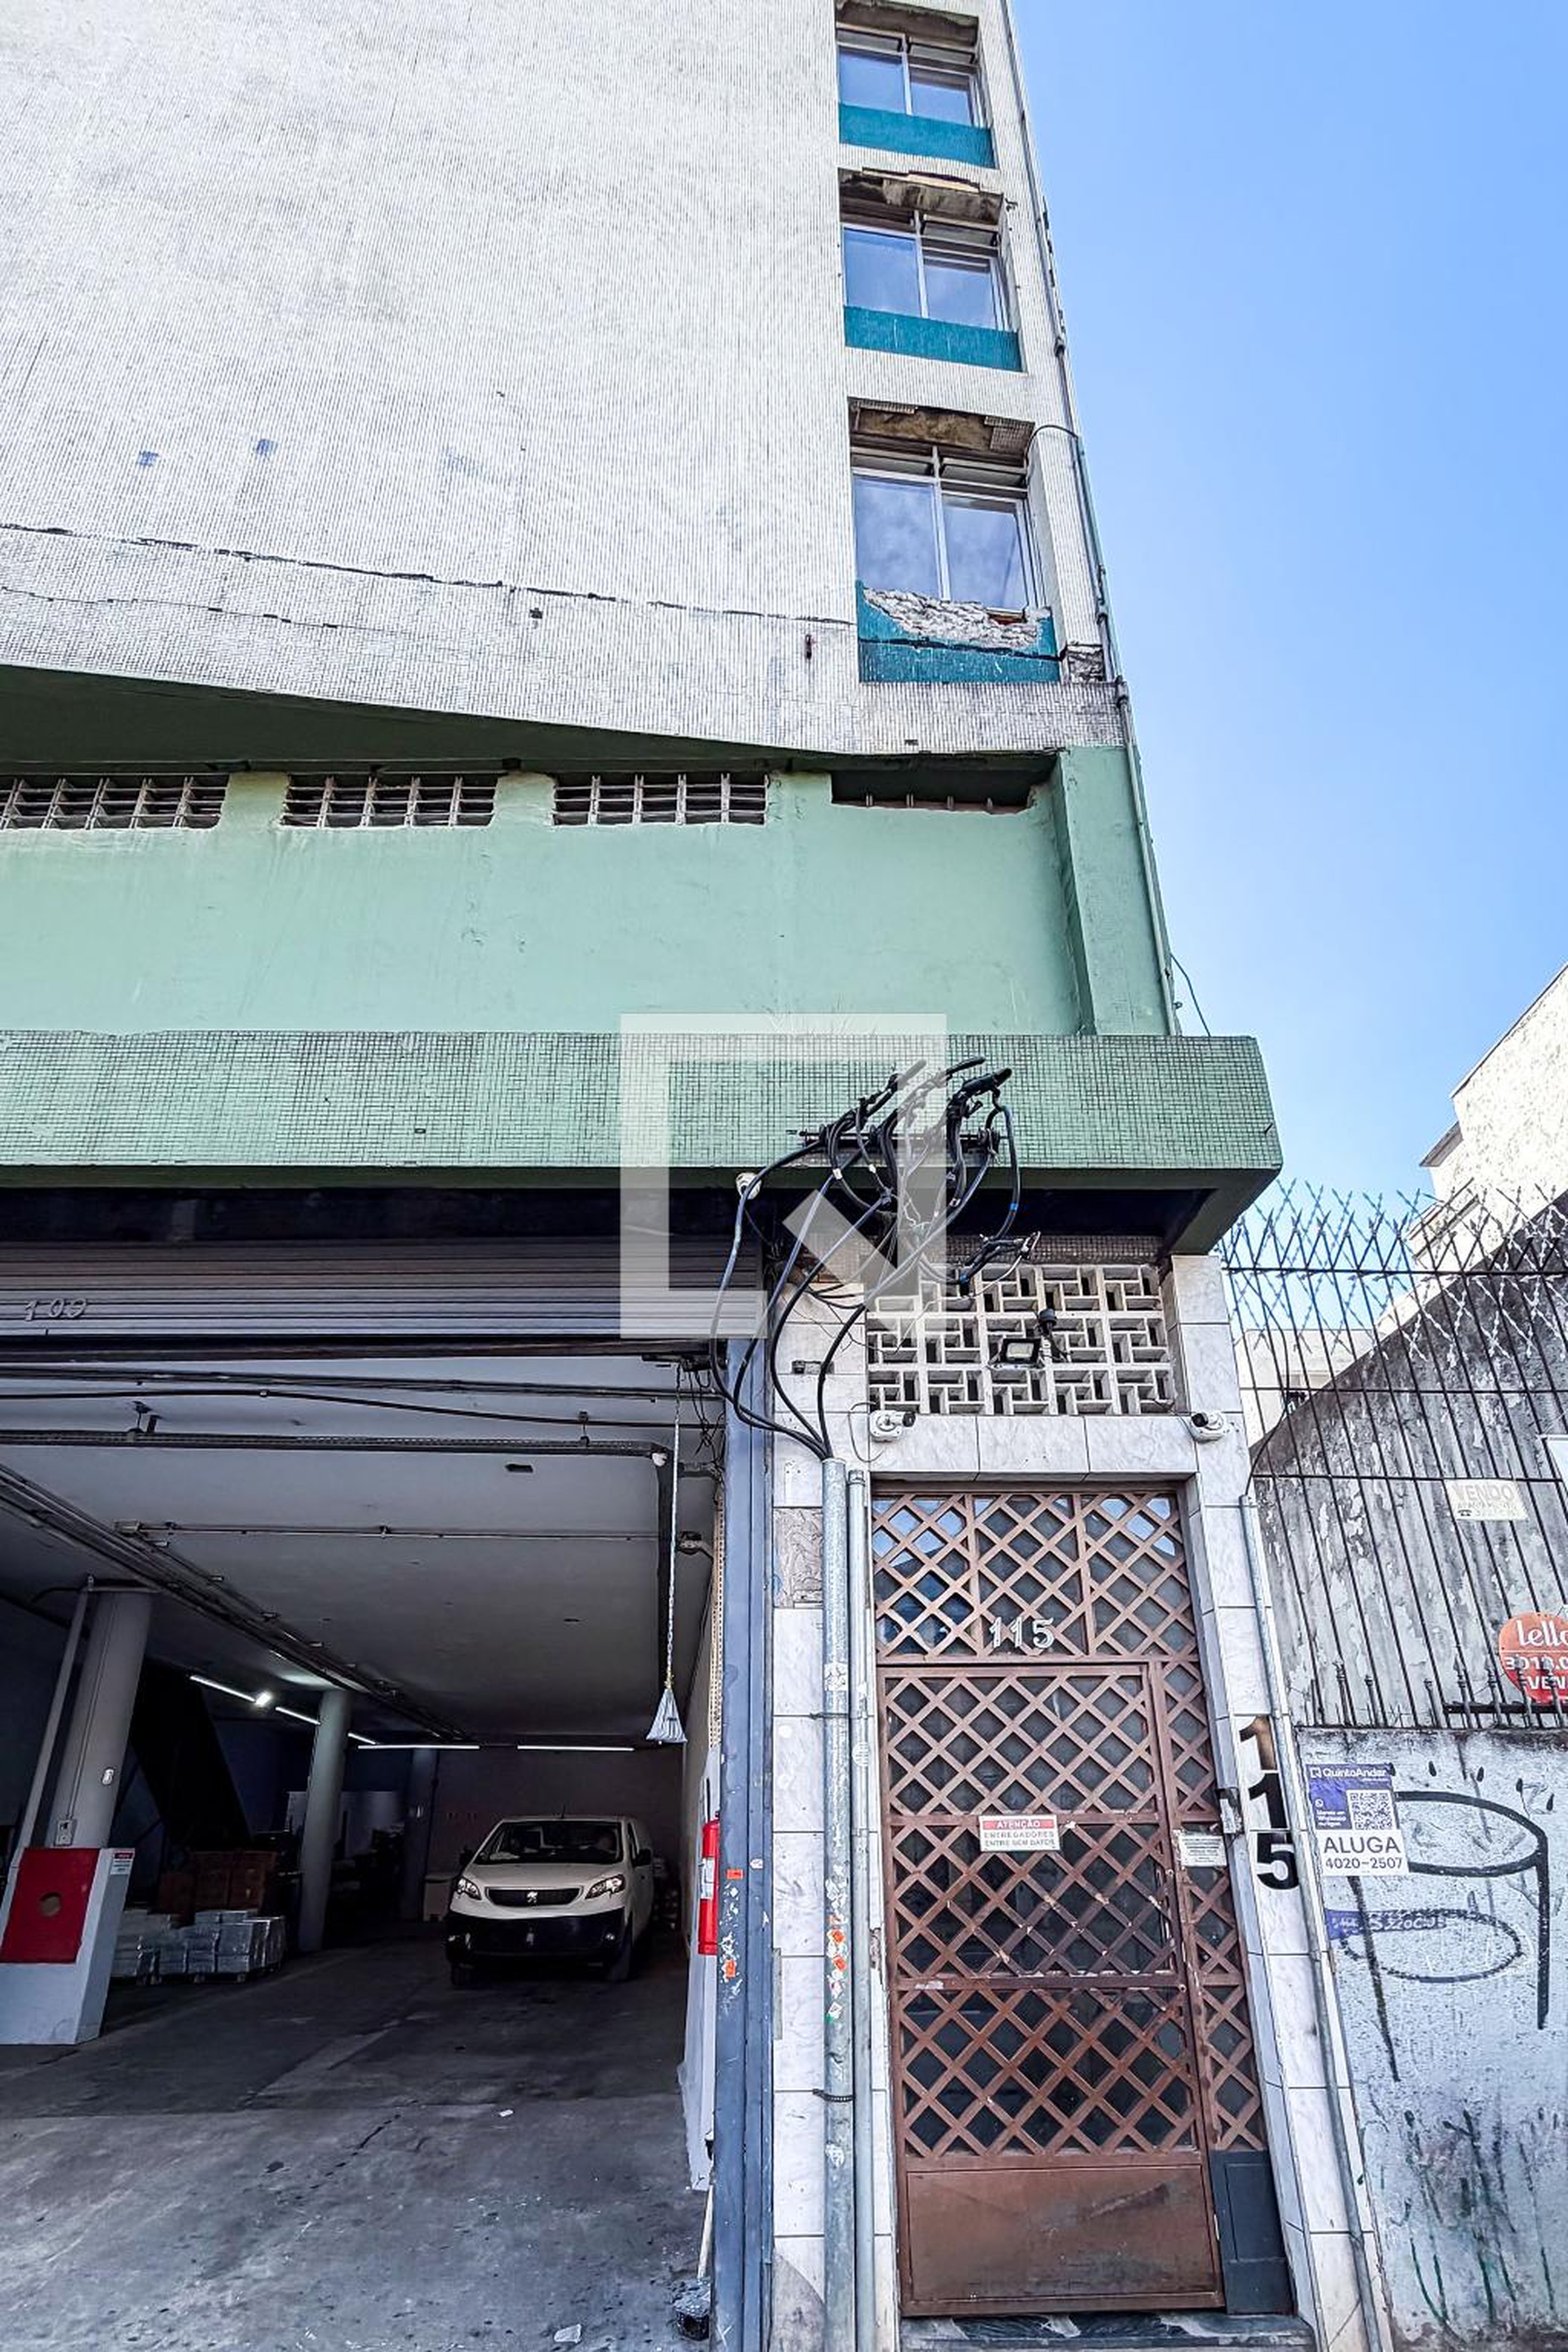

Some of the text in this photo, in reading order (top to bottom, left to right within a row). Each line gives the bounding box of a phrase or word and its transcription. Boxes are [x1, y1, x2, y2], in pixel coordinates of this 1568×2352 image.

[1452, 1483, 1514, 1502] VENDO
[989, 1616, 1055, 1648] 115
[1322, 1768, 1387, 1777] QuintoAndar
[1239, 1715, 1299, 1890] 115
[996, 1820, 1041, 1829] ATENÇÃO
[1323, 1837, 1401, 1853] ALUGA
[1325, 1858, 1402, 1869] 4020-2507
